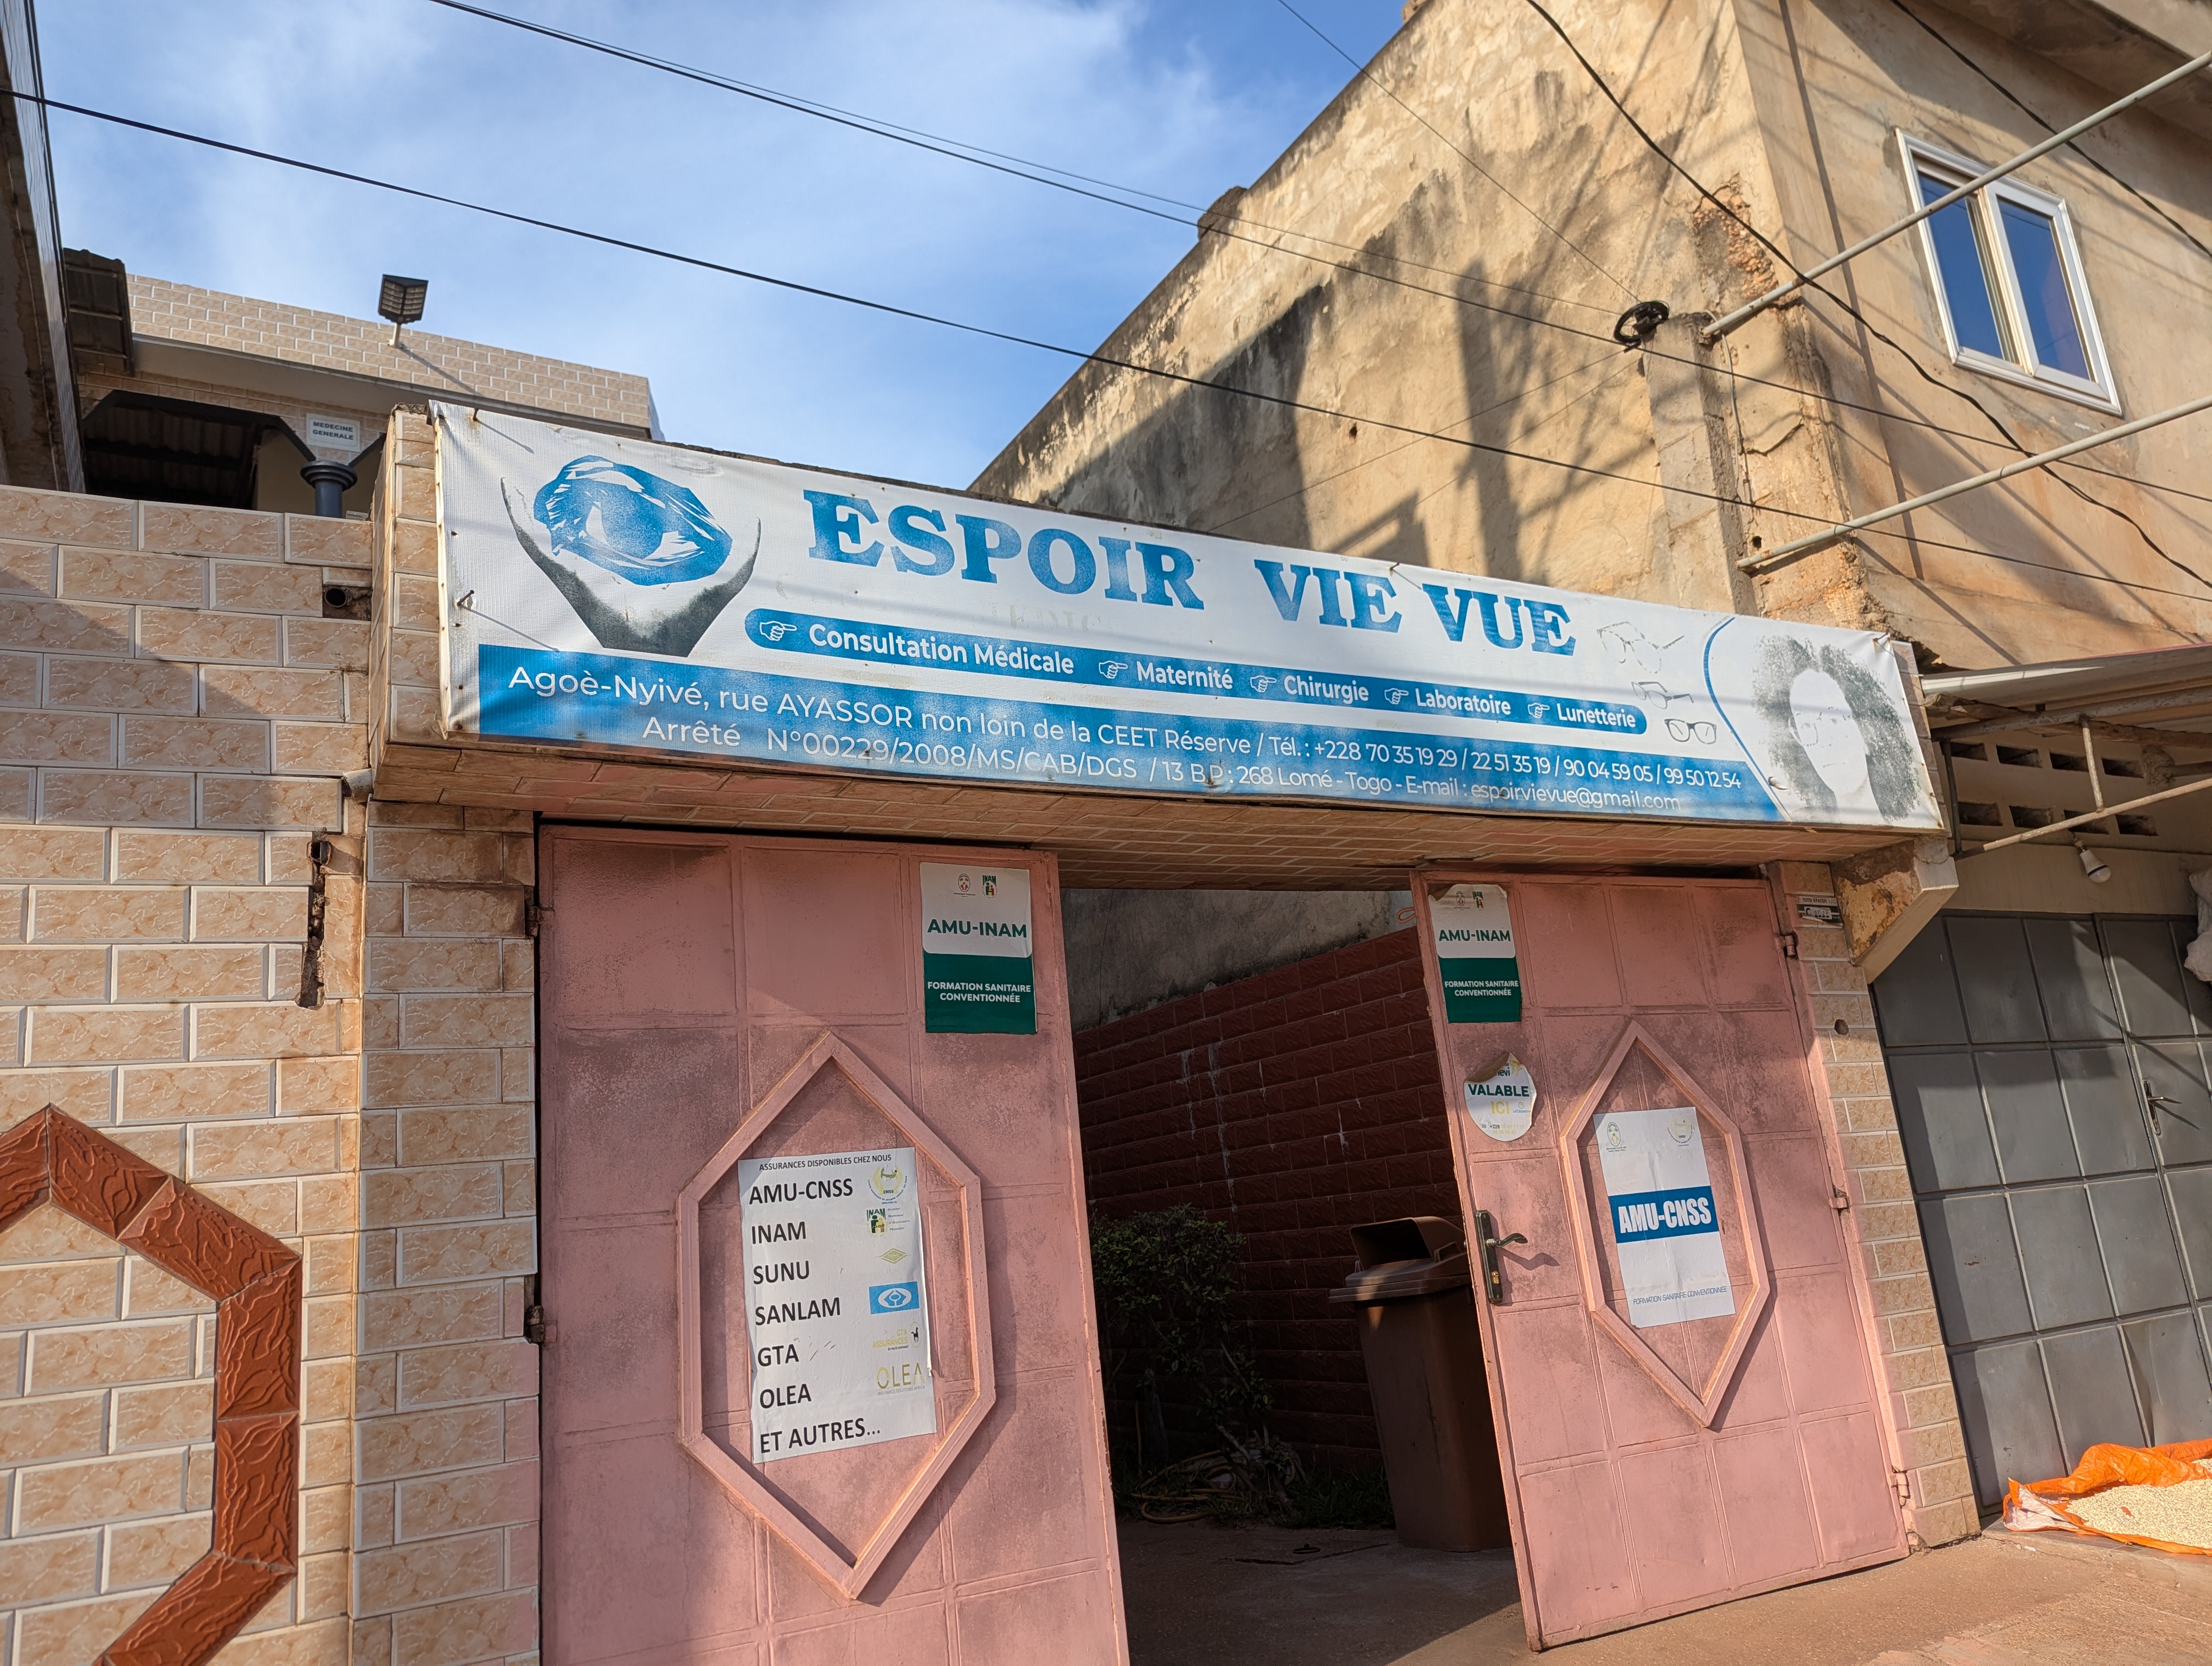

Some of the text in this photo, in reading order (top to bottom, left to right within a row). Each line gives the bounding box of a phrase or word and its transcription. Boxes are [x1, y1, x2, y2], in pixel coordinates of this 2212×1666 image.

[313, 421, 353, 432] MEDECINE
[313, 430, 354, 440] GENERALE
[803, 489, 1577, 656] ESPOIR VIE VUE
[809, 624, 1636, 728] Consultation Médicale Maternité Chirurgie Laboratoire Lunetterie
[509, 667, 710, 710] Agoè-Nyivé,
[720, 690, 768, 713] rue
[777, 693, 912, 728] AYASSOR
[922, 713, 972, 733] non
[980, 713, 1025, 738] loin
[1033, 718, 1064, 740] de
[1071, 720, 1091, 743] la
[1098, 724, 1158, 747] CEET
[1165, 729, 1251, 754] Réserve
[1256, 732, 1264, 757] /
[1315, 740, 1362, 761] +228
[1366, 743, 1390, 762] 70
[1392, 745, 1414, 764] 35
[1415, 746, 1433, 766] 19
[1436, 748, 1457, 767] 29
[1461, 748, 1467, 770] /
[1471, 752, 1491, 771] 22
[1494, 753, 1509, 772] 51
[1512, 755, 1533, 773] 35
[1533, 756, 1551, 774] 19
[1554, 755, 1560, 777] /
[1564, 759, 1585, 777] 90
[1587, 761, 1610, 779] 04
[1612, 763, 1630, 780] 59
[1634, 765, 1653, 782] 05
[1656, 764, 1661, 785] /
[1664, 767, 1683, 784] 99
[1686, 769, 1705, 786] 50
[1705, 771, 1722, 787] 12
[1722, 772, 1741, 789] 54
[642, 716, 741, 747] Arrêté
[767, 728, 1137, 779] N°00229/2008/MS/CAB/DGS
[1162, 760, 1184, 781] 13
[1237, 766, 1274, 786] 268
[1277, 770, 1333, 789] Lomé
[1345, 771, 1392, 796] Togo
[1405, 776, 1458, 797] E-mail
[1471, 781, 1681, 810] espoirvievue@gmail.com
[1806, 908, 1811, 916] C
[927, 918, 1027, 938] AMU-INAM
[1439, 930, 1511, 942] AMU-INAM
[928, 981, 1031, 993] FORMATION SANITAIRE
[1455, 988, 1512, 996] CONVENTIONNÉE
[940, 992, 1020, 1003] CONVENTIONNÉE
[1468, 1084, 1529, 1097] VALABLE
[1491, 1100, 1510, 1115] ICI
[759, 1161, 806, 1171] ASSURANCES
[807, 1157, 852, 1168] DISPONIBLES
[853, 1156, 870, 1164] CHEZ
[749, 1178, 853, 1205] AMU-CNSS
[866, 1208, 886, 1221] INAM
[1618, 1197, 1712, 1234] AMU-CNSS
[751, 1221, 806, 1245] INAM
[753, 1260, 810, 1285] SUNU
[1633, 1285, 1727, 1305] FORMATION SANITAIRE CONVENTIONNÉE
[755, 1297, 841, 1326] SANLAM
[873, 1337, 909, 1348] ASSURANCES
[758, 1344, 799, 1367] GTA
[877, 1362, 925, 1389] OLEA
[760, 1383, 812, 1408] OLEA
[760, 1418, 880, 1453] ET AUTRES...
